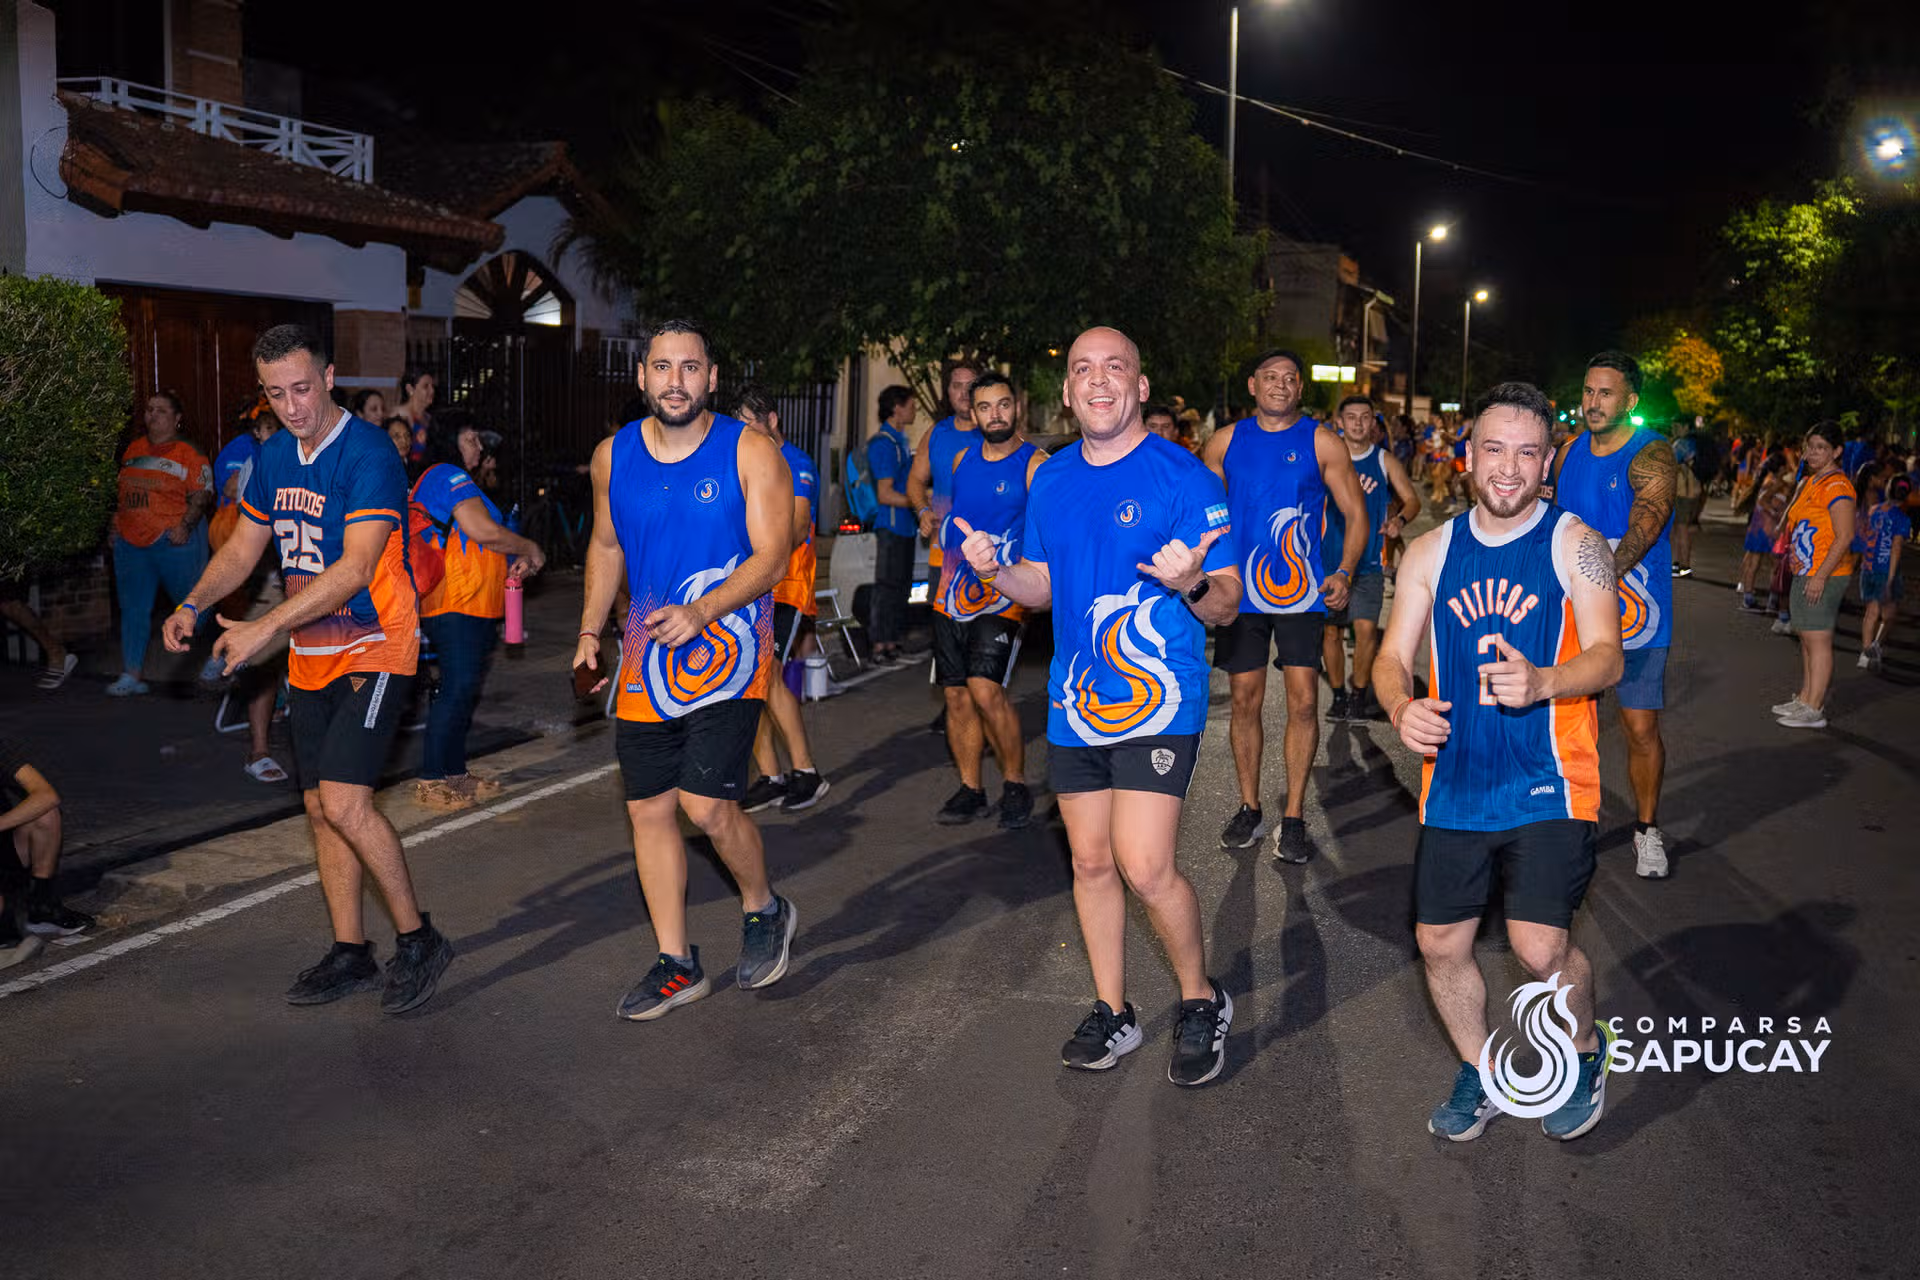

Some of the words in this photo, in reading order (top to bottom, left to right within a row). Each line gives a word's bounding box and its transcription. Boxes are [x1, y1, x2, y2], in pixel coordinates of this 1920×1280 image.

[273, 486, 326, 518] PITUCOS
[273, 519, 325, 574] 25
[1530, 785, 1555, 796] GAMBA
